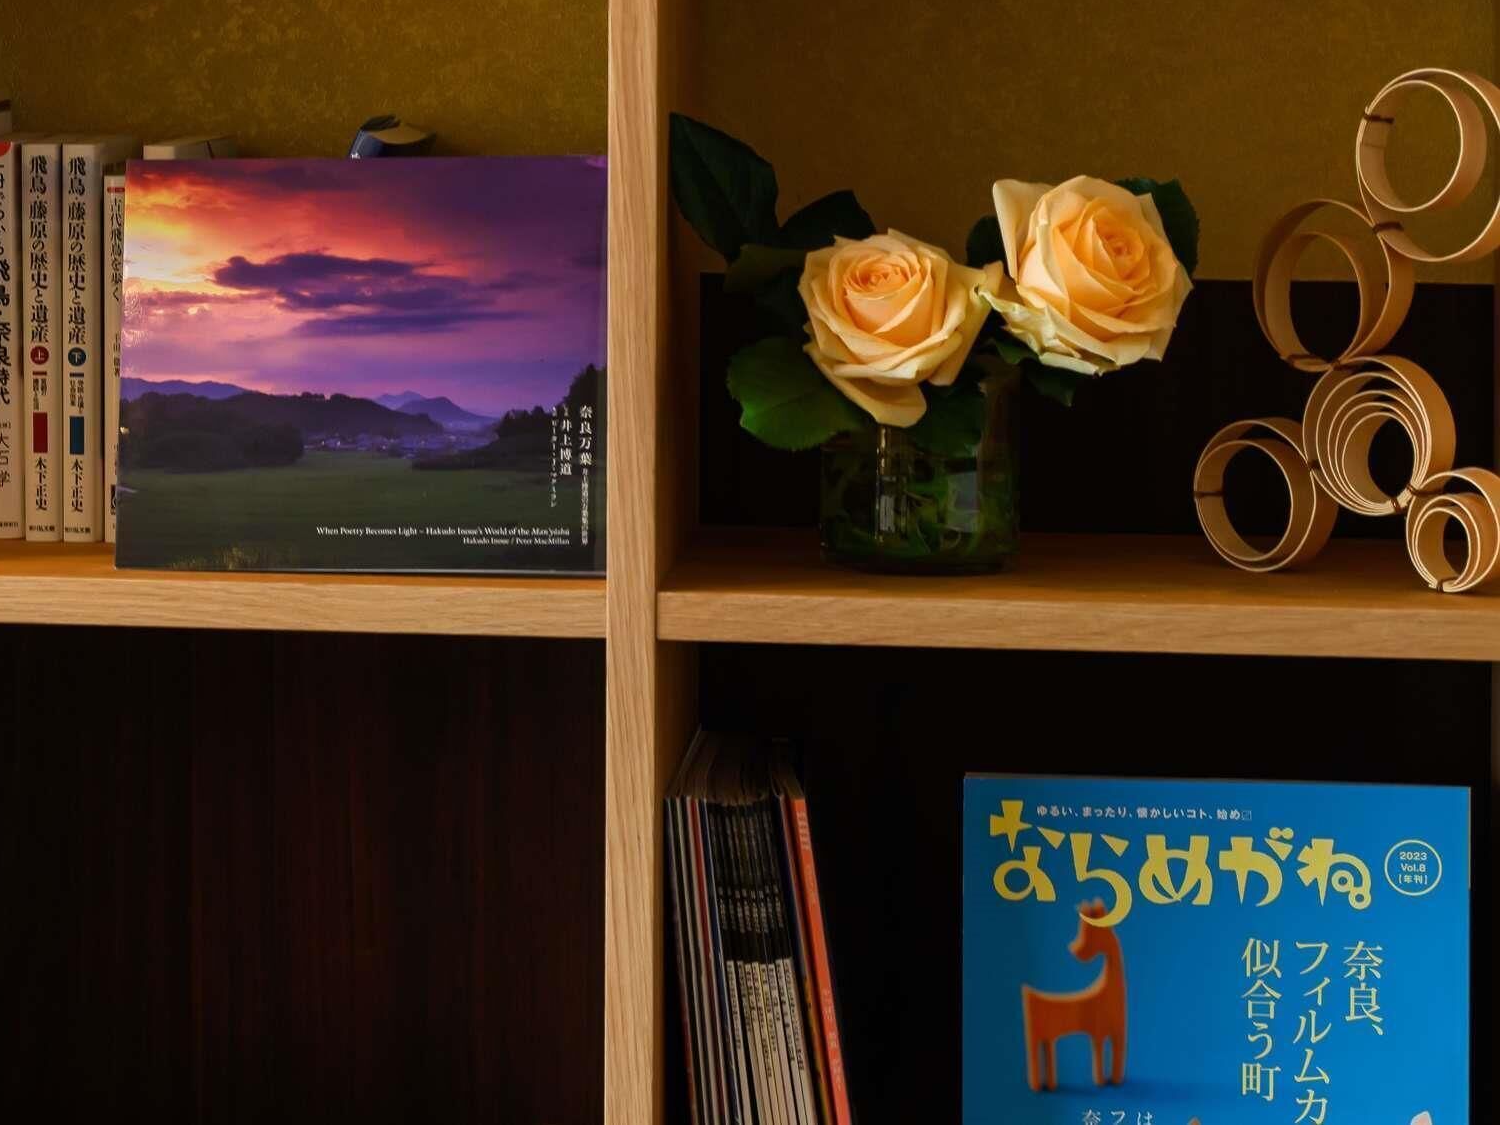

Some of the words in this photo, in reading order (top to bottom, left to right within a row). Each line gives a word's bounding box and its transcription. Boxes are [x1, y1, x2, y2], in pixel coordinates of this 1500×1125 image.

[29, 155, 49, 343] 飛鳥・藤原の歴史と遺産
[68, 155, 86, 344] 飛鳥・藤原の歴史と遺産
[560, 419, 573, 475] 井上博道
[579, 405, 592, 466] 奈良万葉
[35, 458, 48, 511] 木下正史
[71, 459, 84, 513] 木下正史
[316, 526, 339, 536] When
[340, 526, 364, 537] Poetry
[365, 526, 397, 536] Becomes
[398, 526, 418, 537] Light
[426, 527, 456, 536] Hakudo
[485, 526, 507, 536] World
[508, 526, 517, 536] of
[517, 526, 530, 536] the
[463, 537, 490, 546] Hakudo
[491, 537, 509, 546] Inoue
[516, 537, 534, 546] Peter
[534, 537, 570, 546] MacMillan
[990, 799, 1372, 927] ならめがね
[1399, 851, 1427, 861] 2023
[1343, 940, 1384, 1036] 奈良、
[1241, 937, 1282, 1101] 似合う町
[1293, 940, 1331, 1125] フィルムカ
